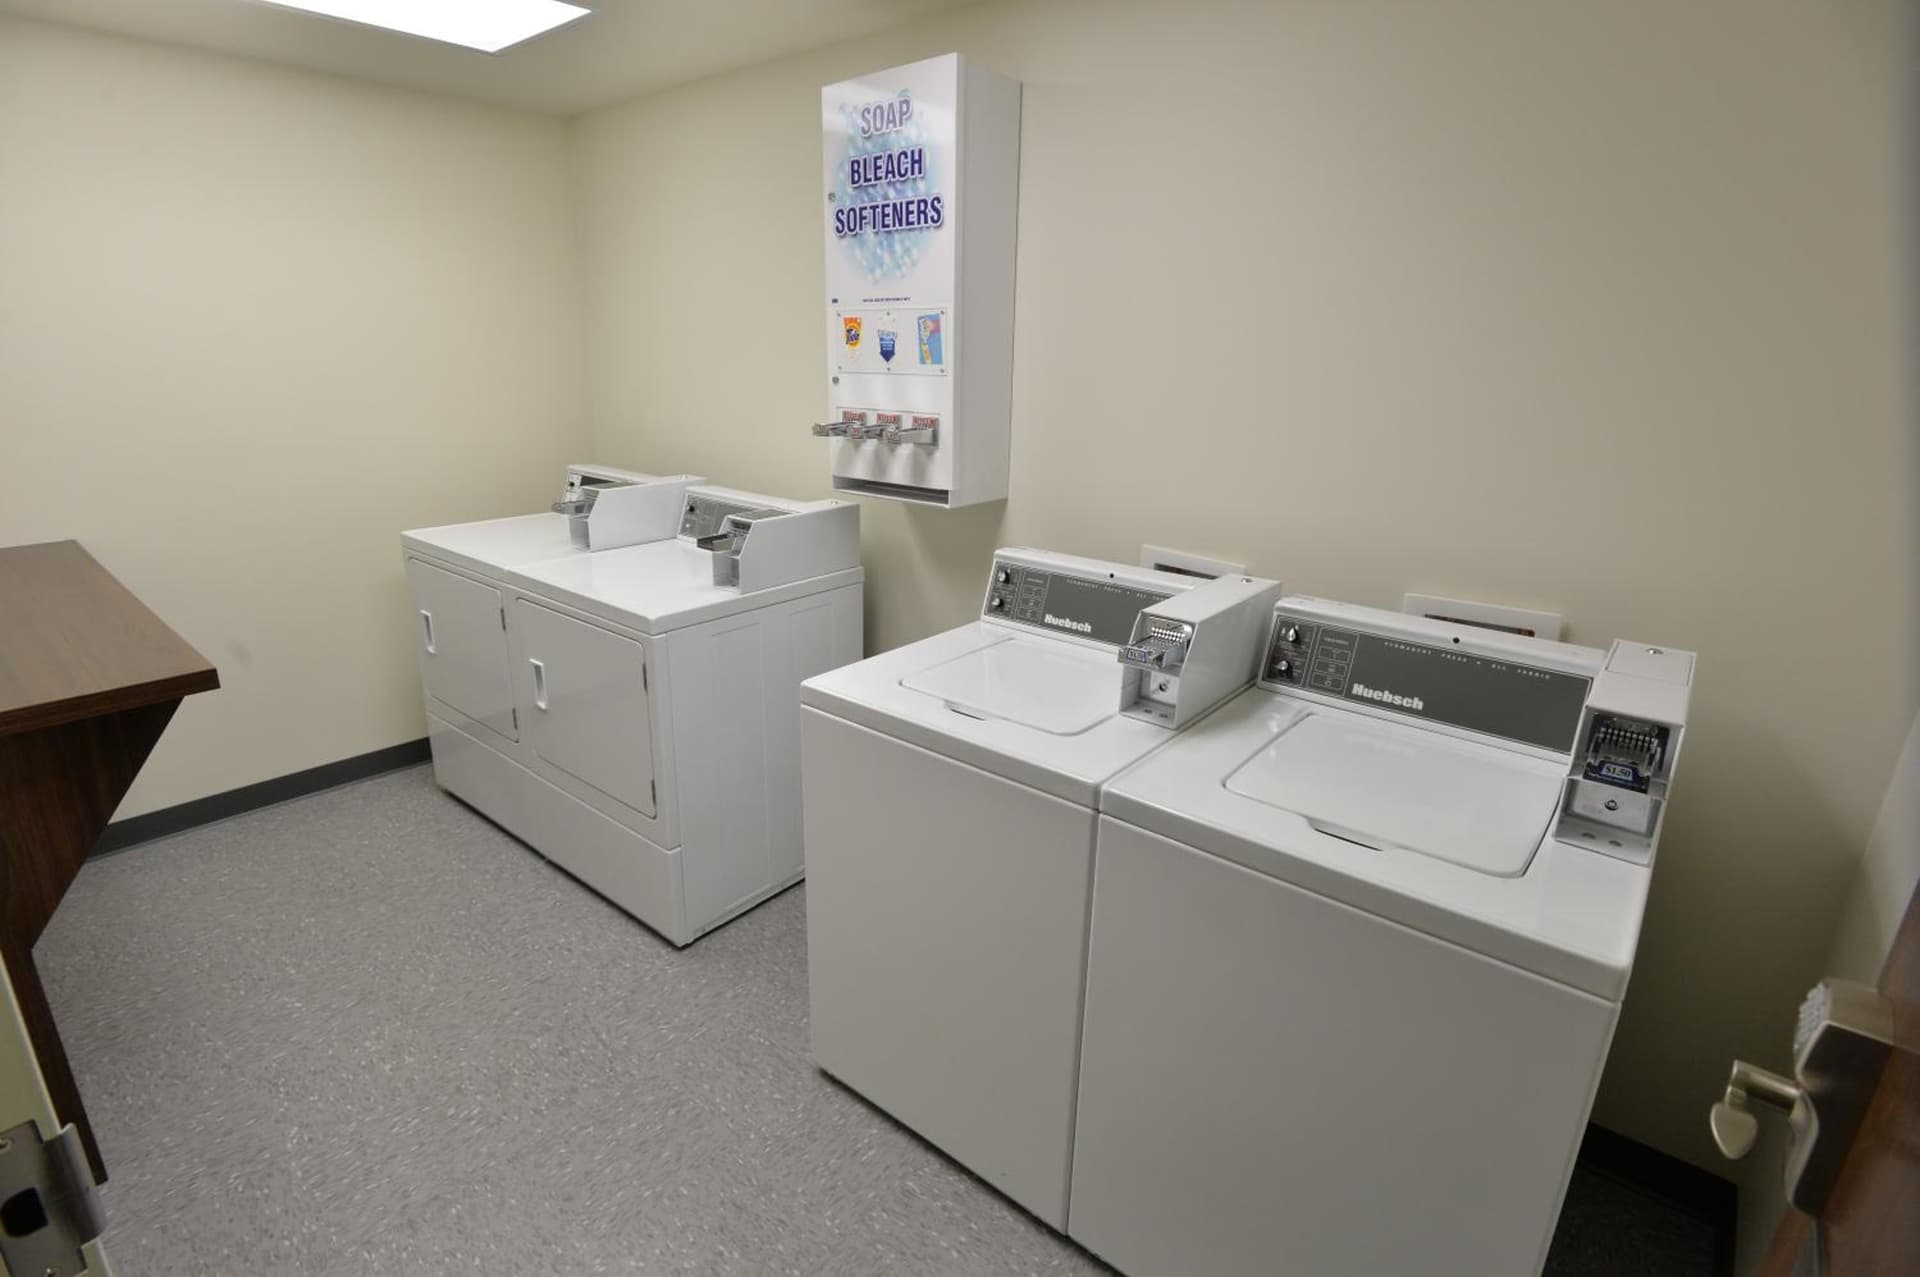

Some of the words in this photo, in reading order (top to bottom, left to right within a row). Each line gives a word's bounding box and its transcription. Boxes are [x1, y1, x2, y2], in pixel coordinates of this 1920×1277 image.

[860, 98, 911, 136] SOAP
[850, 147, 923, 186] BLEACH
[835, 196, 942, 235] SOFTENERS
[1044, 613, 1092, 633] Huebsch
[1352, 683, 1424, 711] Huebsch
[1605, 766, 1631, 779] $1.50
